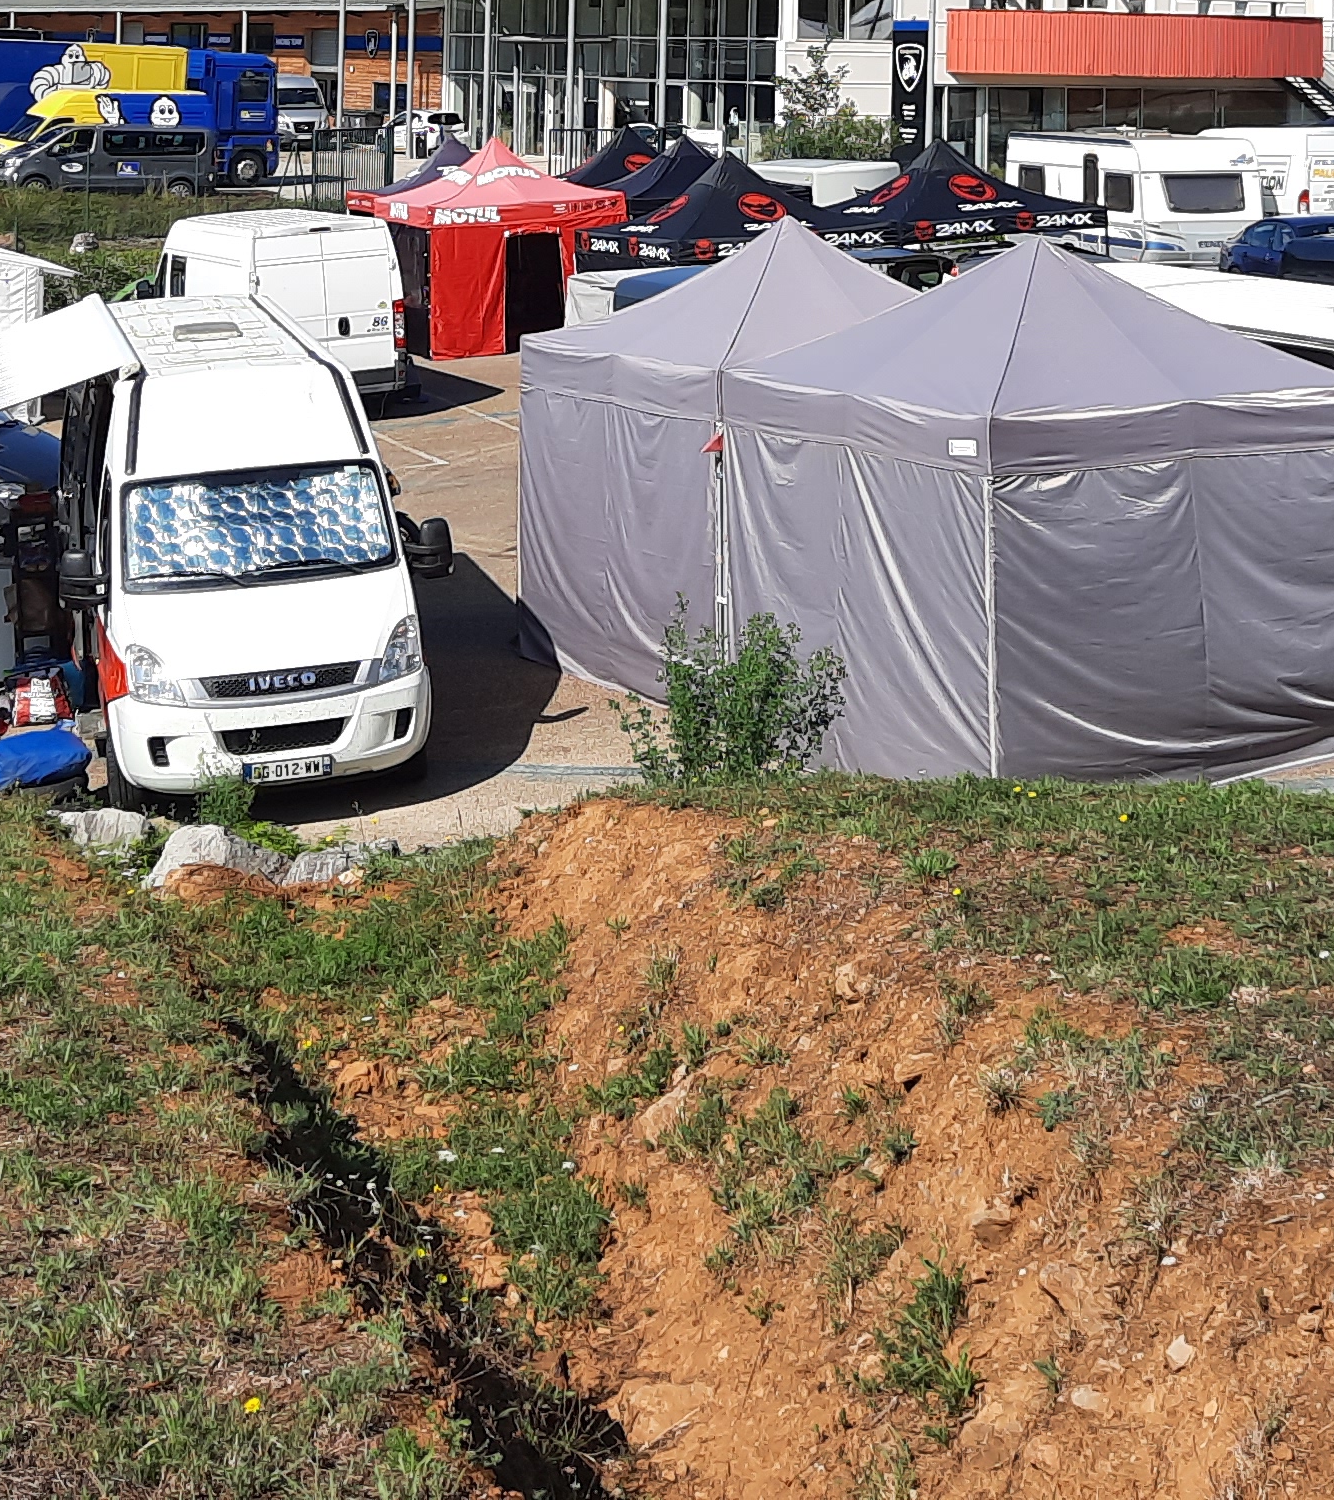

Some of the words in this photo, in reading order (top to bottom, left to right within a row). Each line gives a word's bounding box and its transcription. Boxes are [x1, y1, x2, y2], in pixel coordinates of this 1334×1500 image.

[476, 166, 541, 186] MOTUL
[432, 206, 502, 226] MOTUL
[1036, 212, 1094, 228] 24MX
[936, 218, 996, 237] 24MX
[591, 237, 619, 254] 24MX
[824, 231, 885, 245] 24MX
[638, 244, 671, 261] 24MX
[718, 242, 745, 257] 24
[249, 672, 317, 692] IVECO
